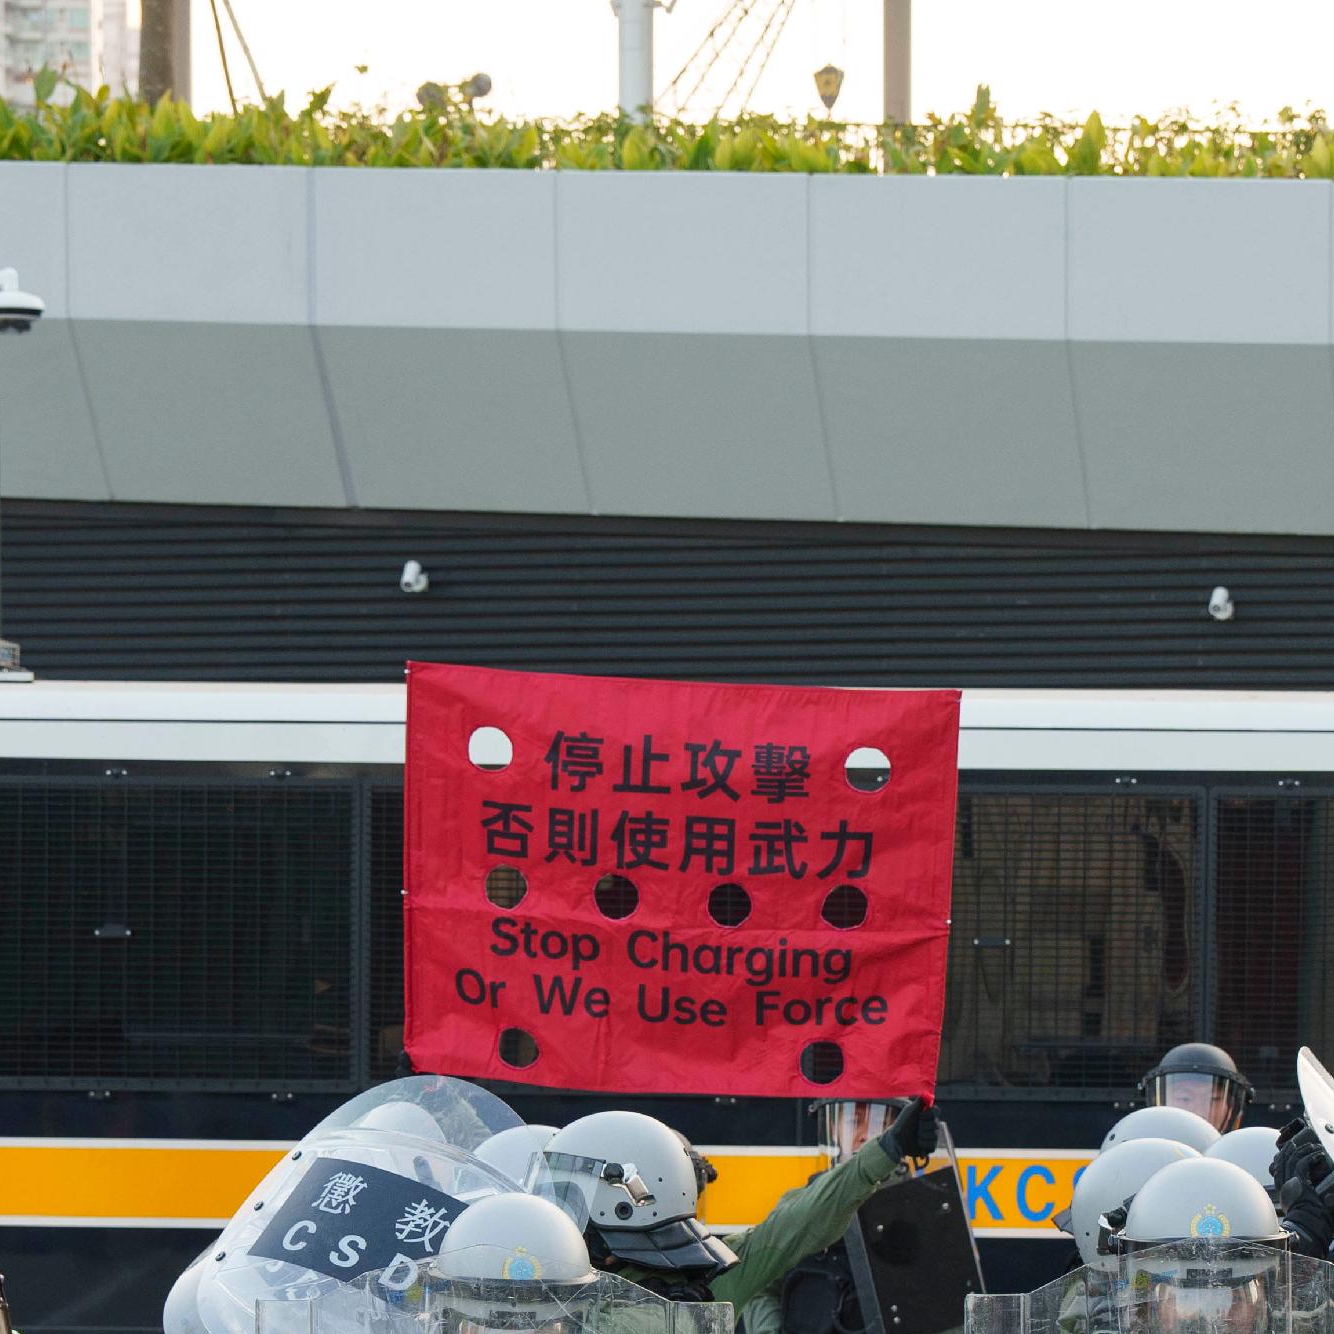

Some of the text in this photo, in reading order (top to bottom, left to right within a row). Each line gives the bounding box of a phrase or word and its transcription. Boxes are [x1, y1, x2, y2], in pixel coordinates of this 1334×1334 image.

[544, 730, 812, 804] 停止攻擊
[481, 800, 875, 880] 否則使用武力
[490, 917, 853, 986] Stop Charging
[455, 968, 888, 1027] Or We Use Force
